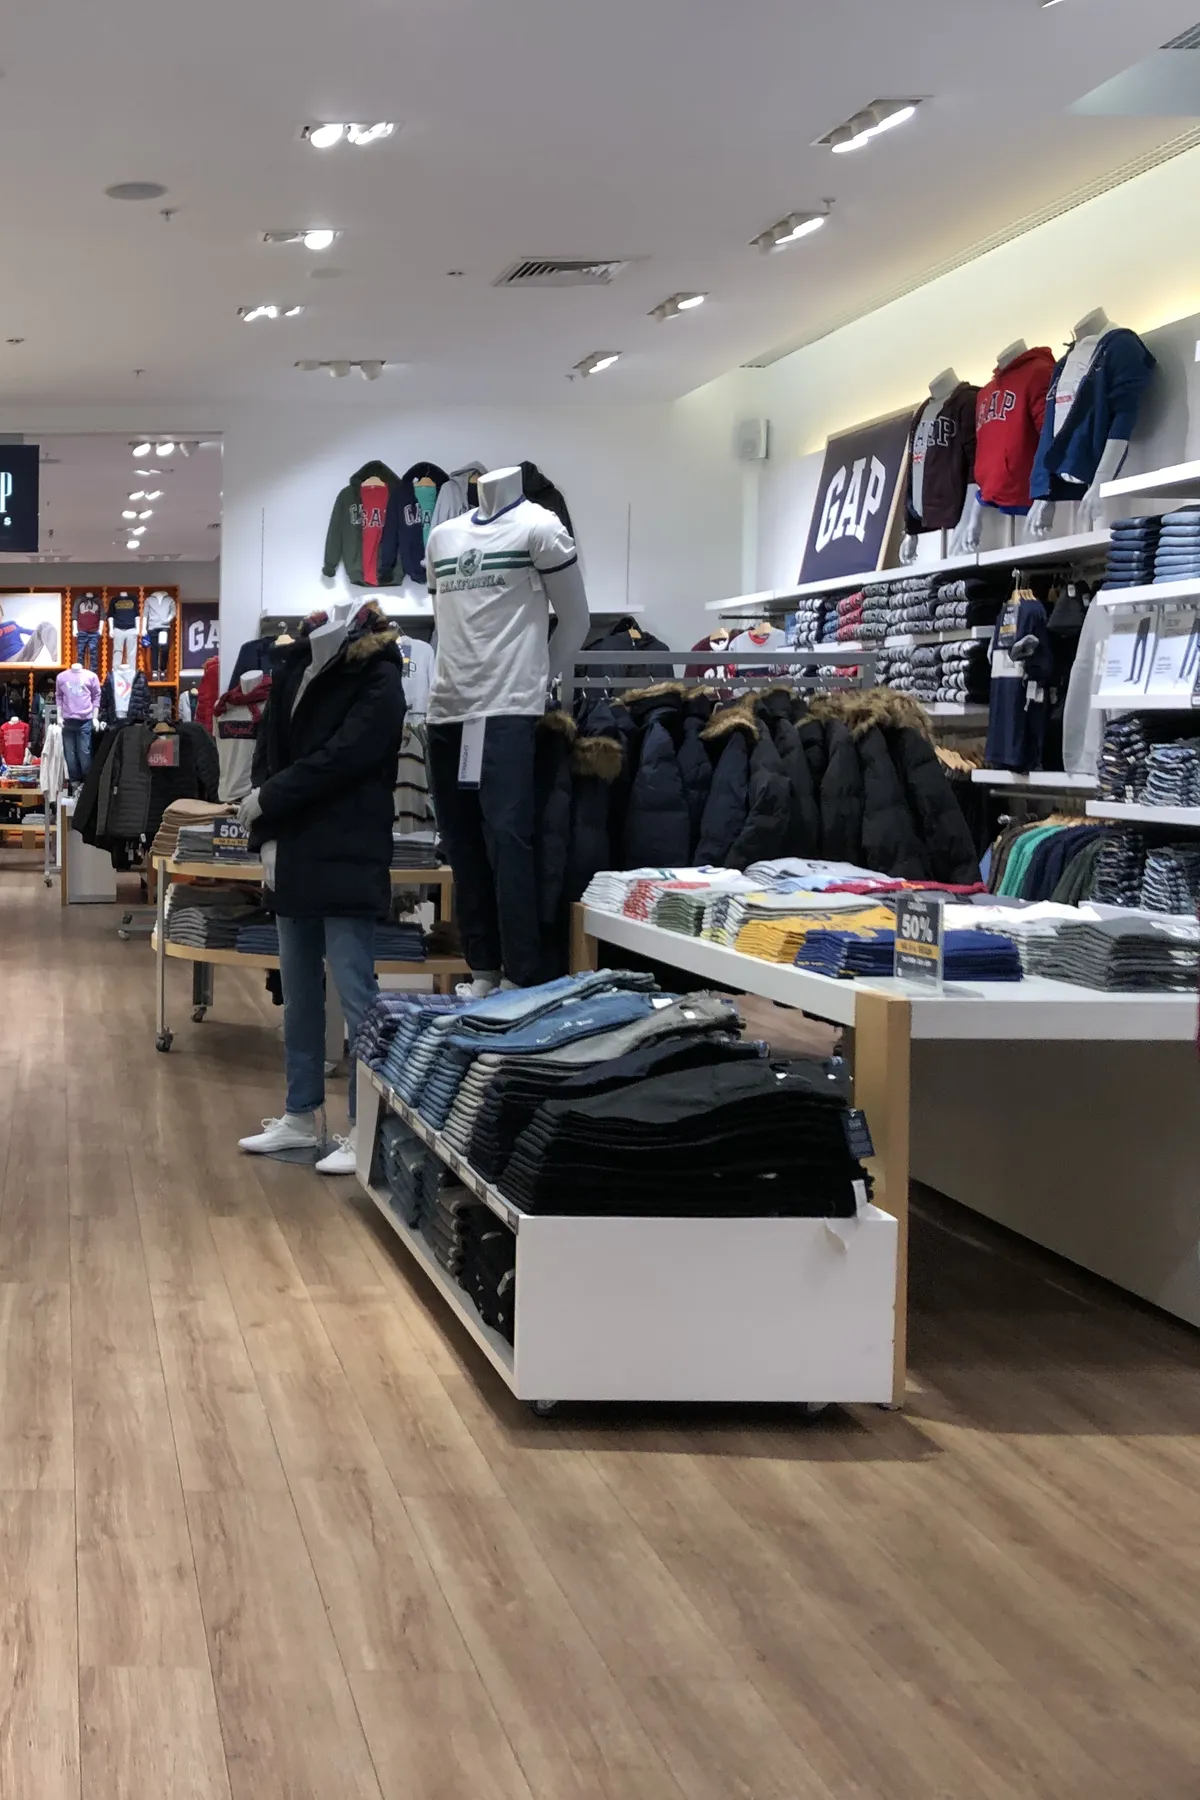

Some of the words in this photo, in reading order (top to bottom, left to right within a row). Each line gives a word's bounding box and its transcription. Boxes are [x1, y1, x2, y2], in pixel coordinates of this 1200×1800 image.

[815, 454, 887, 553] GAP
[440, 574, 506, 594] CALIFORNIA
[902, 913, 933, 942] 50%
